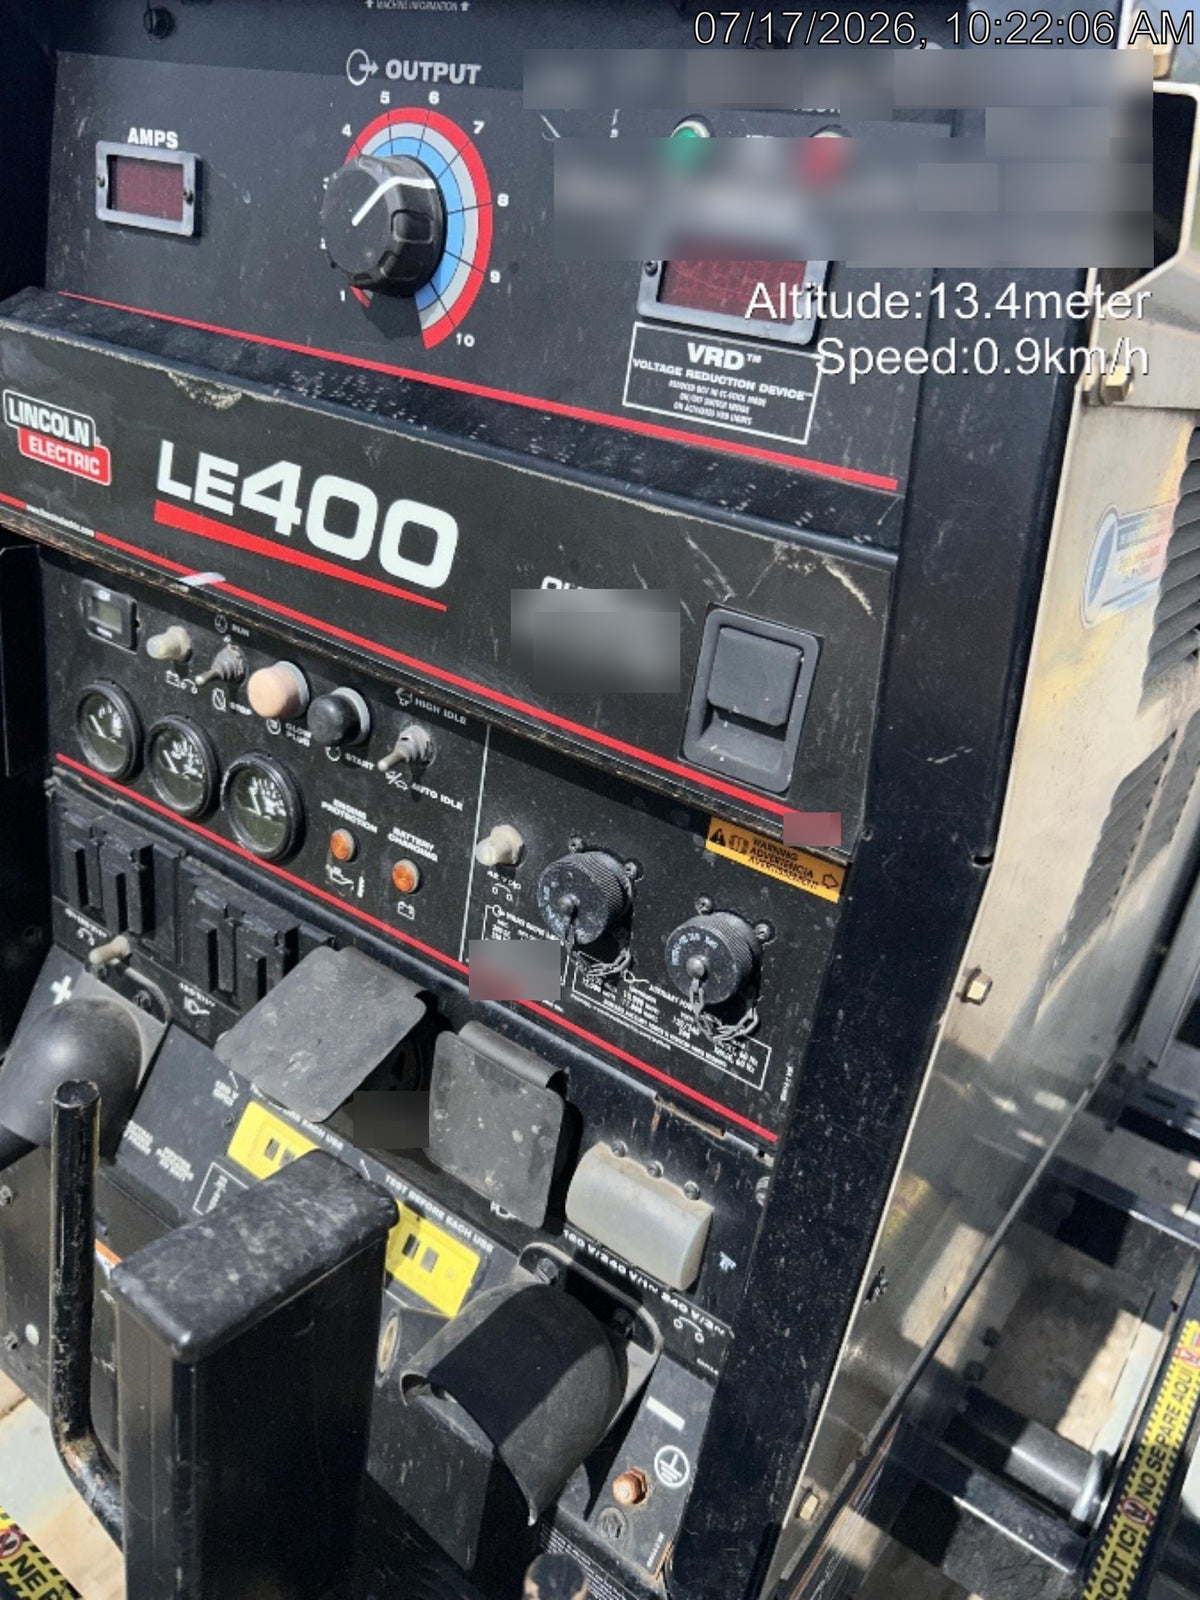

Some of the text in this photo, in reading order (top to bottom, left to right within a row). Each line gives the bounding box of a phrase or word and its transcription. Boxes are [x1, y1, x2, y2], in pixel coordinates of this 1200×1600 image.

[385, 59, 482, 85] OUTPUT
[380, 90, 390, 104] 5
[428, 90, 440, 105] 6
[127, 127, 179, 150] AMPS
[342, 123, 351, 137] 4
[473, 121, 484, 134] 7
[497, 194, 509, 207] 8
[490, 270, 501, 284] 9
[340, 289, 346, 302] 1
[456, 333, 475, 347] 10
[633, 358, 683, 377] VOLTAGE
[685, 369, 756, 391] REDUCTION
[8, 396, 90, 447] LINCOLN
[28, 434, 101, 476] ELECTRIC
[156, 440, 459, 589] LE400
[230, 702, 252, 715] STOP
[415, 697, 467, 726] HIGH IDLE
[344, 752, 375, 771] START
[411, 782, 463, 811] AUTO IDLE
[321, 801, 378, 834] PROTECTION
[333, 799, 367, 821] ENGINE
[387, 833, 438, 863] CHARGING
[393, 826, 435, 851] BATTERY
[753, 838, 799, 861] WARNING
[750, 847, 814, 879] ADVERTENCIA
[385, 1174, 494, 1254] TEST BEFORE EACH USE
[563, 1229, 586, 1249] 120
[661, 1291, 688, 1314] 240
[1136, 1471, 1158, 1502] NO
[1115, 1523, 1140, 1554] ICI
[9, 1554, 48, 1591] NE
